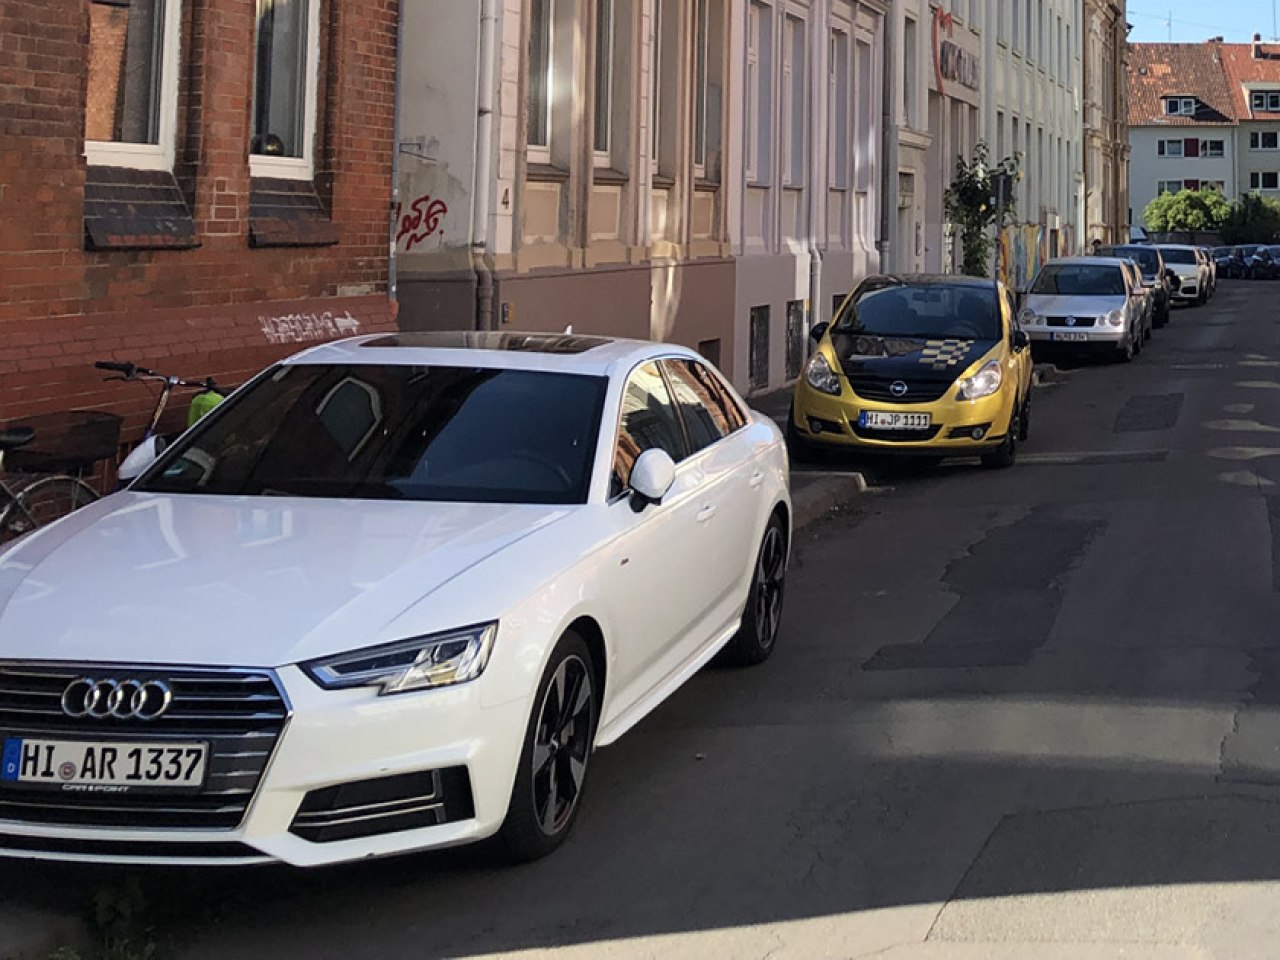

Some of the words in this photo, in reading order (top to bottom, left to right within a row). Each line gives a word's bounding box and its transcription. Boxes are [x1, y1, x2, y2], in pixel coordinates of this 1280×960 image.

[501, 186, 510, 210] 4
[866, 413, 879, 425] HI
[886, 414, 901, 426] JP
[903, 415, 928, 426] 1111
[21, 744, 55, 777] HI
[79, 746, 118, 780] AR
[126, 747, 203, 781] 1337
